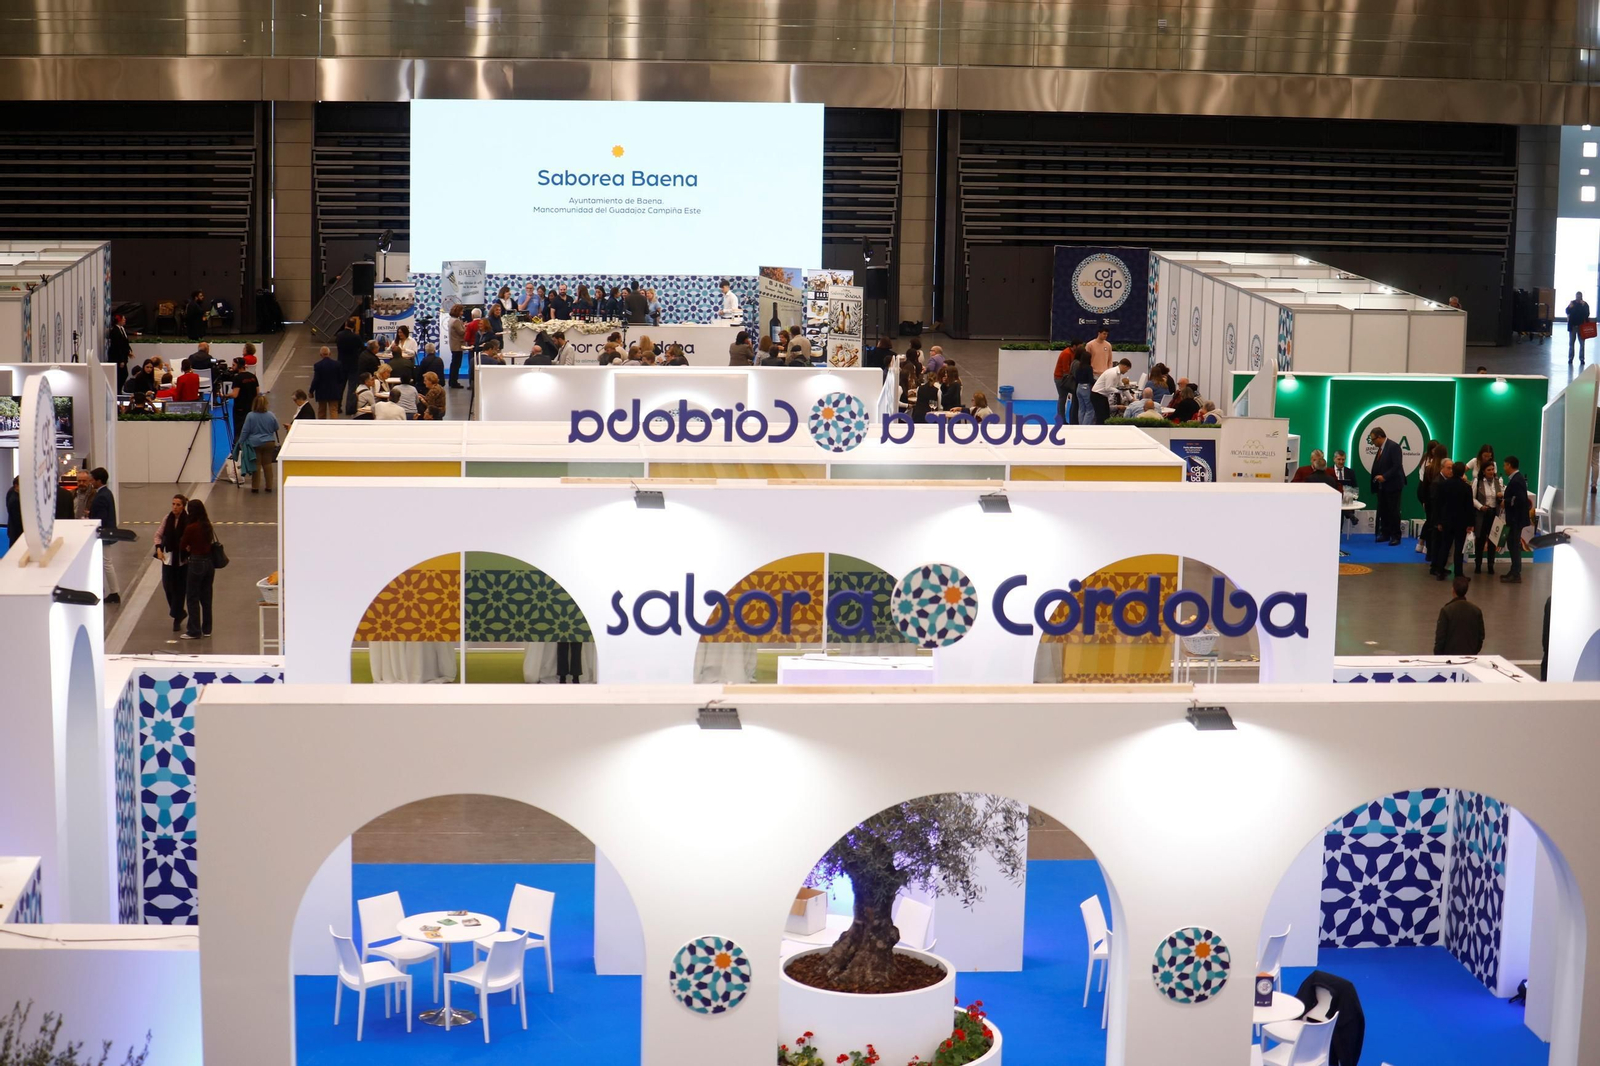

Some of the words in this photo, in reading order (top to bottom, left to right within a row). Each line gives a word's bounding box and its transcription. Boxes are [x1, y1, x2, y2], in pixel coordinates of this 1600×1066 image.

[537, 169, 625, 187] Saborea
[632, 170, 698, 187] Baena
[568, 197, 624, 205] Ayuntamiento
[532, 206, 594, 214] Mancomunidad
[608, 207, 647, 215] Guadajoz
[647, 207, 683, 215] Campiña
[683, 207, 702, 215] Este
[606, 572, 812, 637] sabor
[826, 590, 877, 637] a
